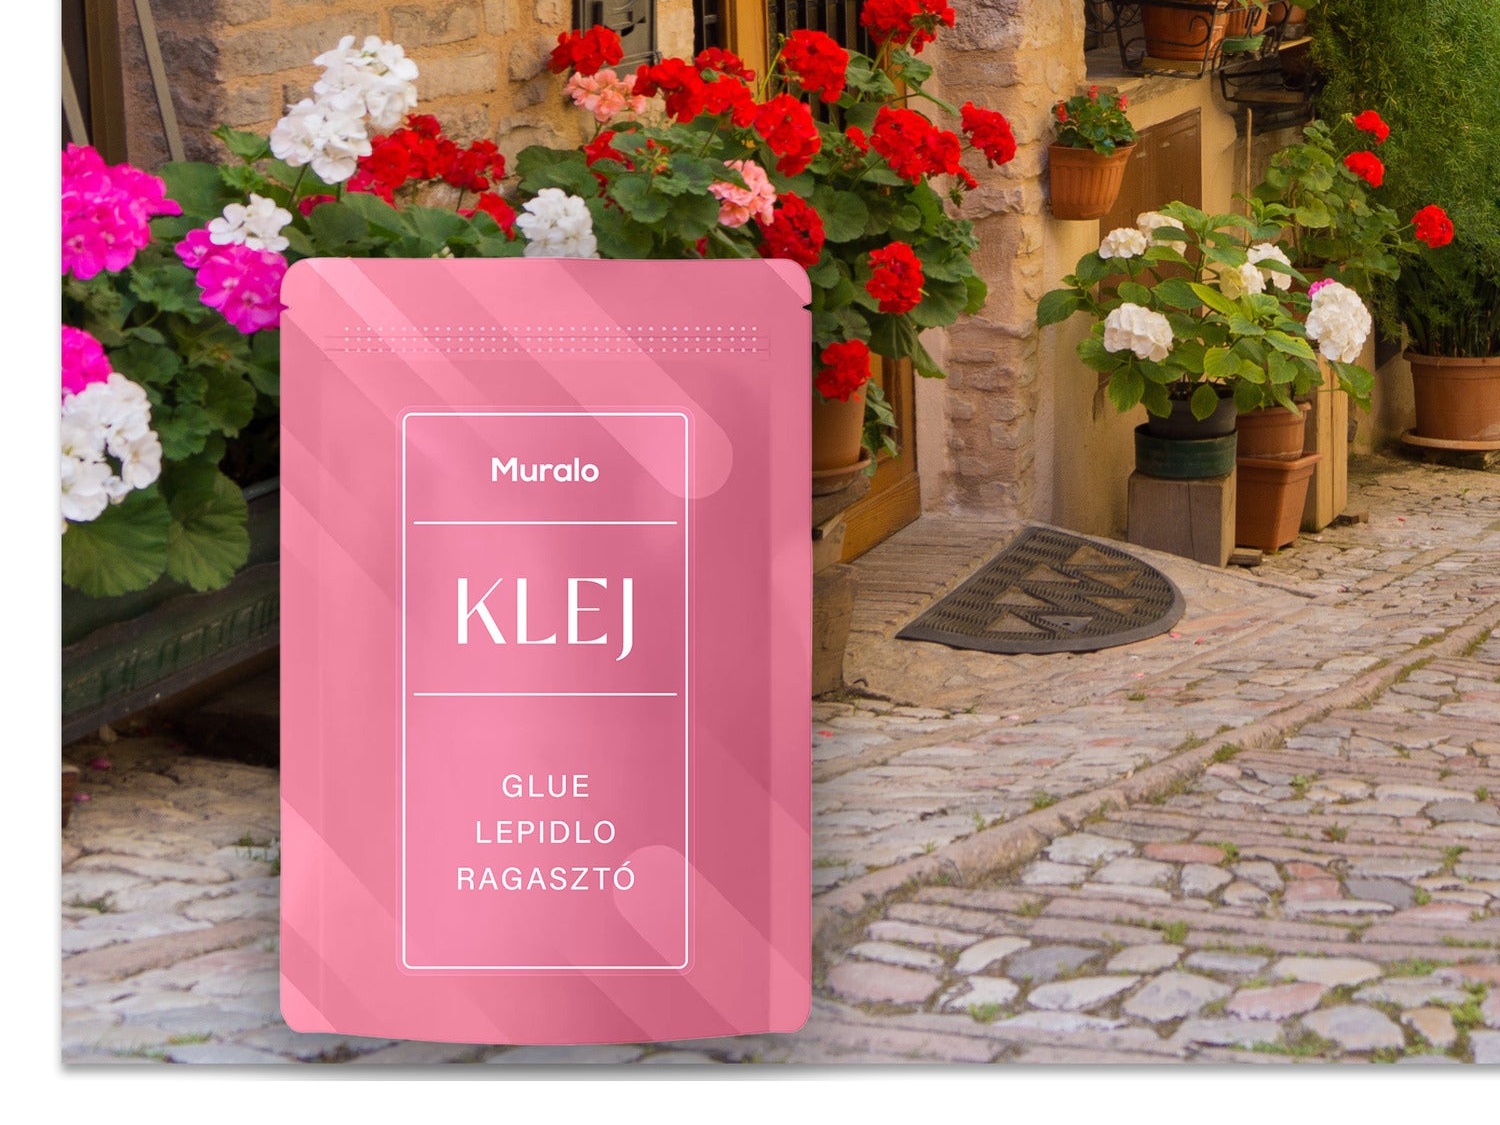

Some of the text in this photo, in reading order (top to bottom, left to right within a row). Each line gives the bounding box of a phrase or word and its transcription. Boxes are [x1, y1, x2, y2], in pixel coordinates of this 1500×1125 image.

[490, 457, 600, 482] Muralo
[456, 577, 634, 661] KLEJ
[502, 773, 589, 798] GLUE
[476, 820, 615, 844] LEPIDLO
[457, 860, 635, 891] RAGASZTÓ
